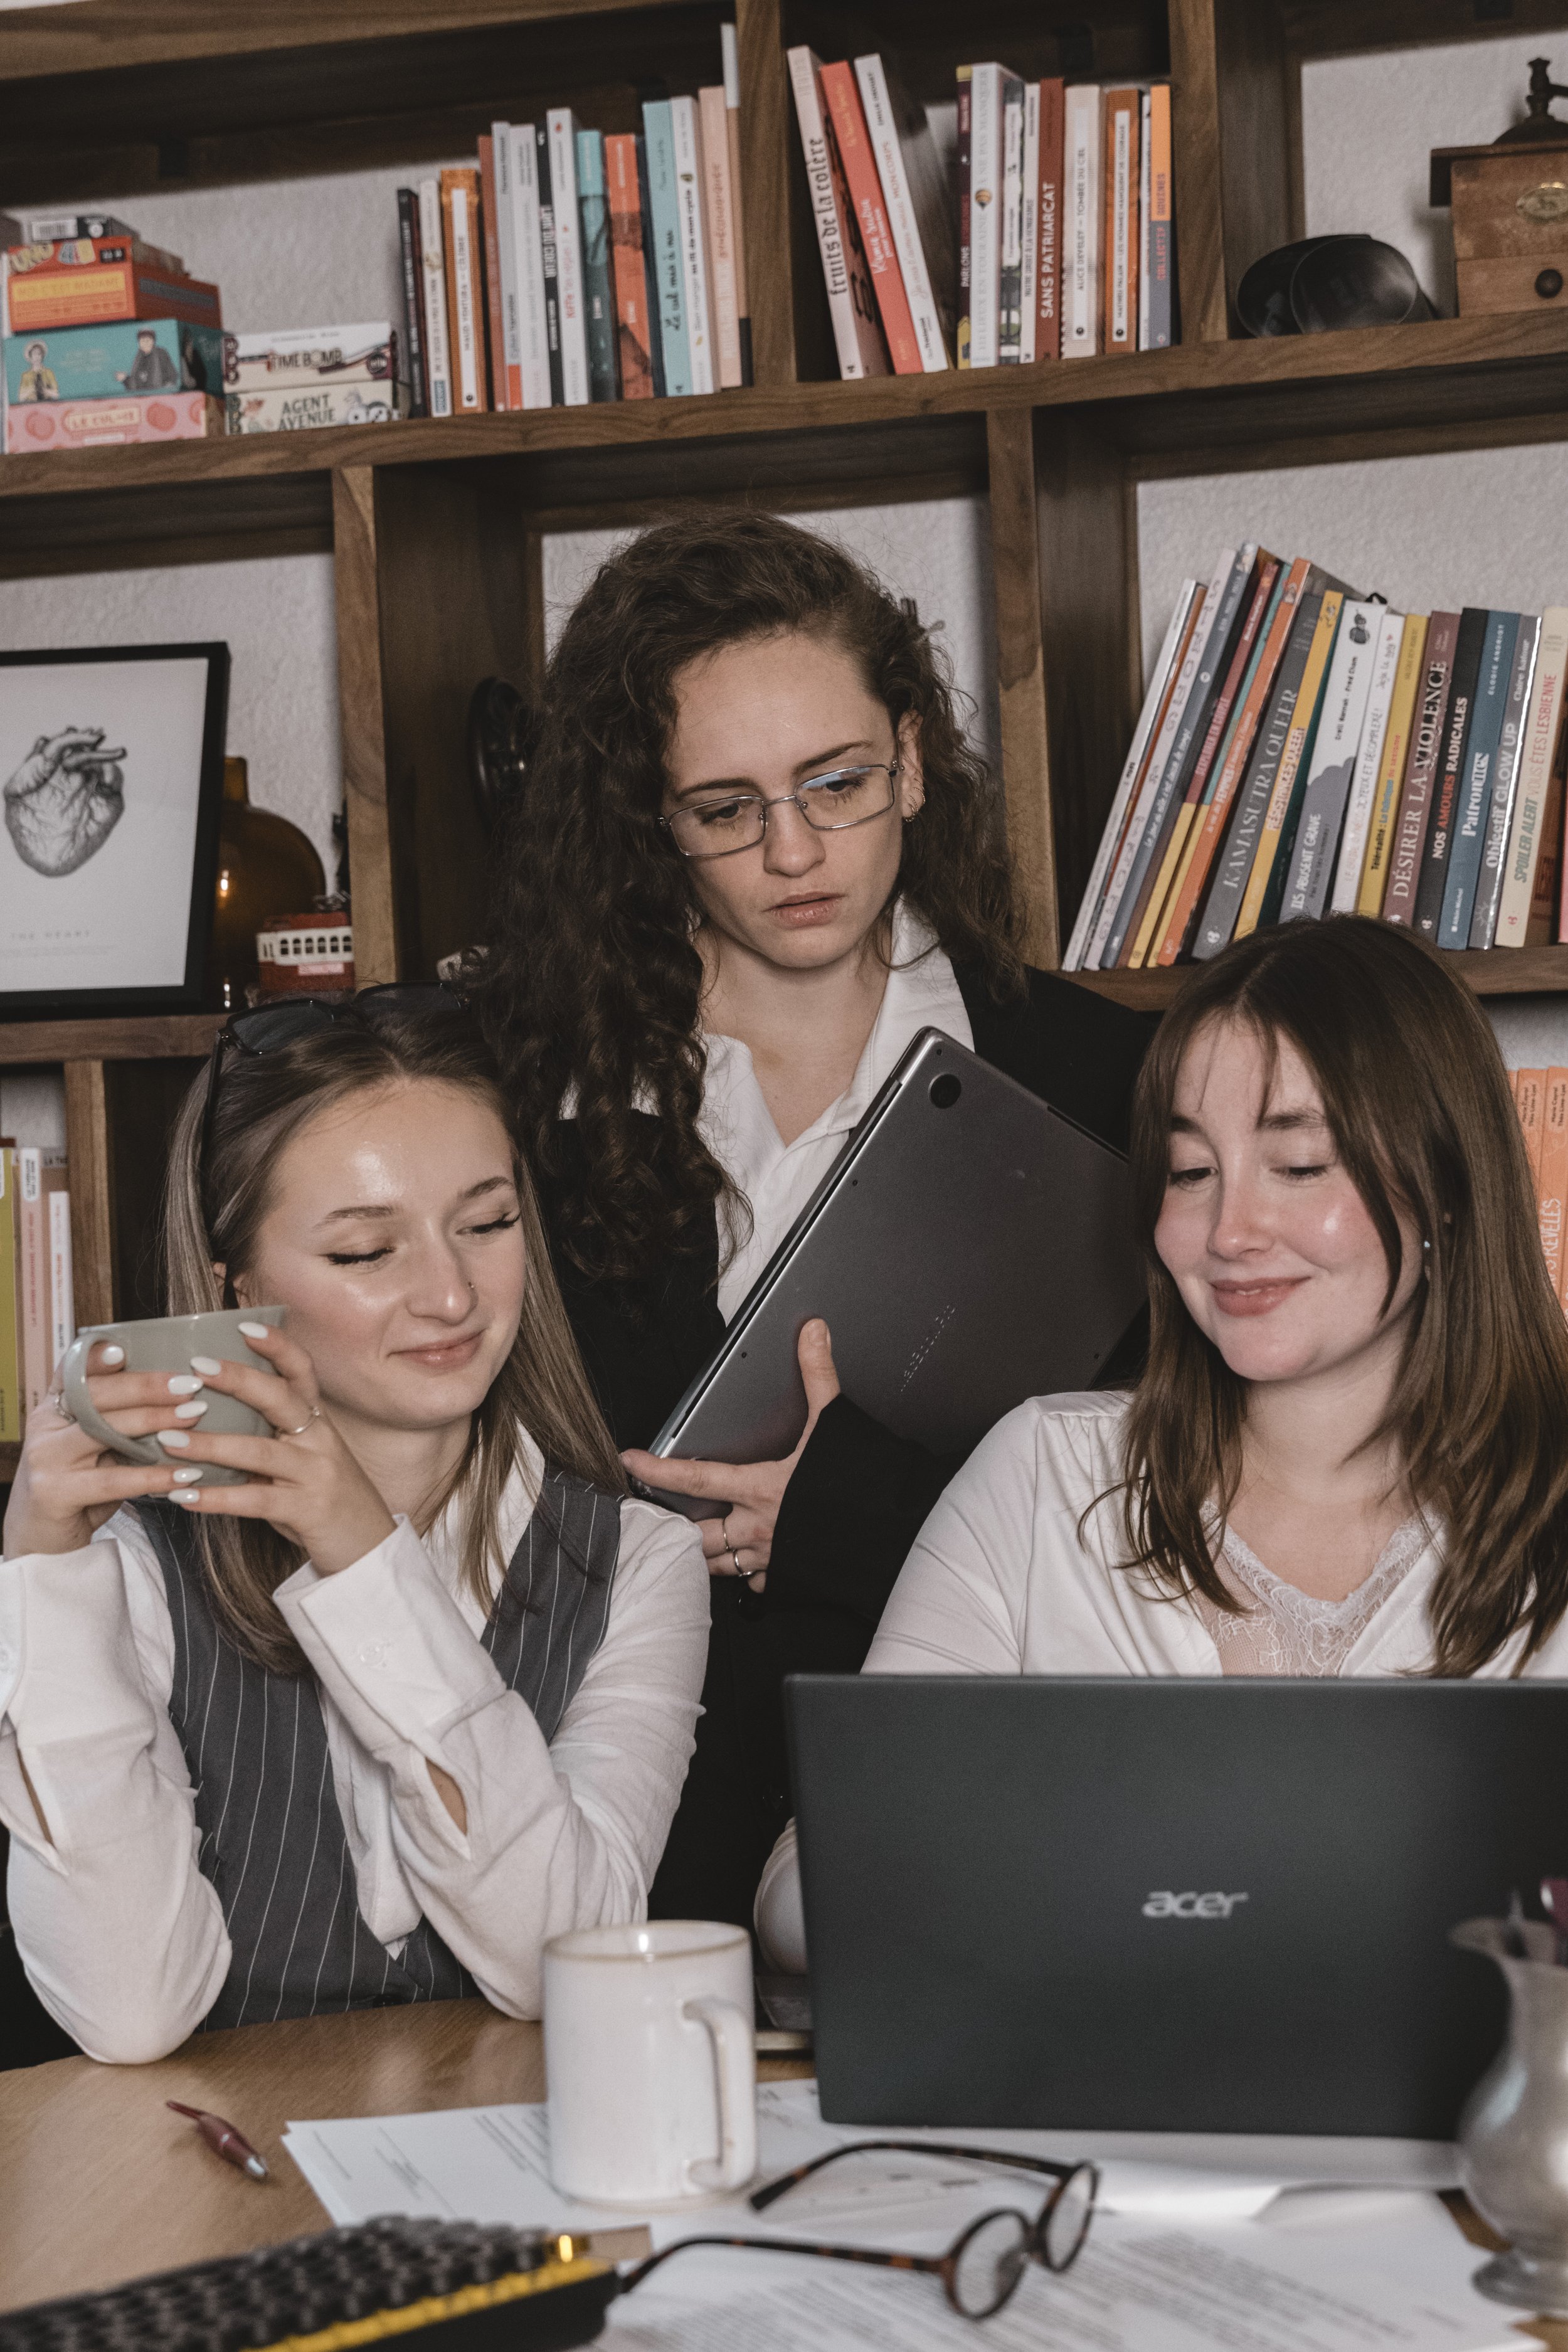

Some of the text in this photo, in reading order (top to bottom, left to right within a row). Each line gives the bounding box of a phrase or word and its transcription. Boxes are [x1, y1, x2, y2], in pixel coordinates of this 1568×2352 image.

[1078, 169, 1084, 179] DU
[803, 137, 847, 297] fruits de la colère
[961, 246, 969, 287] PARLONS
[1041, 184, 1054, 317] SANS PATRIARCAT
[267, 347, 342, 371] TIME BOMB
[278, 408, 336, 431] AVENUE
[282, 394, 329, 414] AGENT
[1513, 673, 1524, 701] Claire
[1537, 675, 1555, 734] LESBIENNE
[1528, 737, 1547, 764] ÊTES
[1224, 763, 1274, 887] KAMASUTRA
[1266, 690, 1297, 756] QUEER
[1393, 664, 1445, 896] DÉSIRER LA VIOLENCE
[1433, 697, 1466, 858] NOS AMOURS RADICALES
[1483, 723, 1517, 867] Objectif GLOW UP
[1304, 814, 1320, 845] GRAVE
[1522, 798, 1537, 834] ALERT
[1514, 835, 1532, 882] SPOILER
[1142, 1890, 1249, 1919] acer
